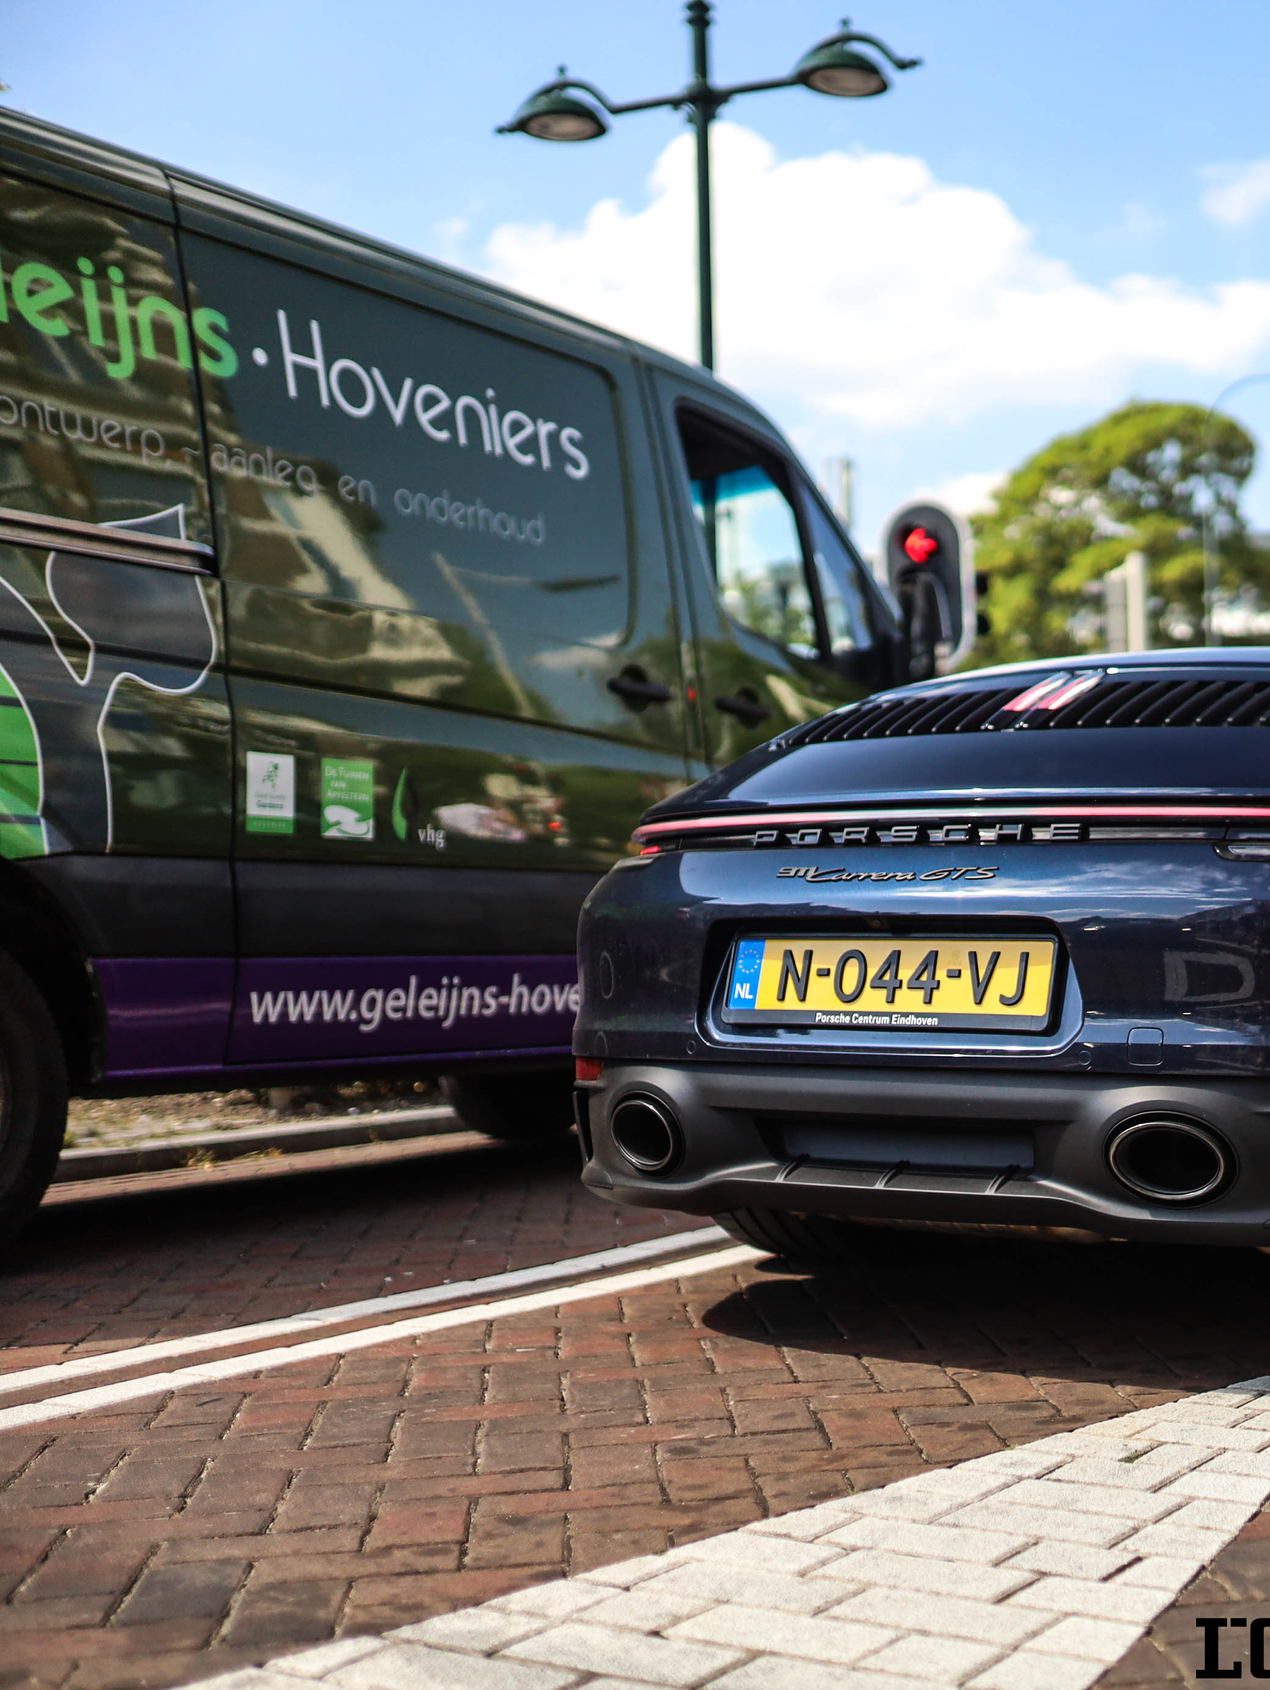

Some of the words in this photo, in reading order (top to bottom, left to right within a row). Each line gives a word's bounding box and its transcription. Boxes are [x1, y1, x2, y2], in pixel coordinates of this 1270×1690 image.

[277, 309, 590, 480] Hoveniers
[210, 442, 319, 500] aanleg
[338, 475, 377, 507] en
[394, 488, 546, 546] onderhoud
[418, 824, 445, 849] vhg
[753, 823, 1081, 847] PORSCHE
[806, 867, 917, 883] Carrera
[919, 866, 999, 881] GTS
[776, 949, 1030, 1006] N-044-VJ
[250, 972, 580, 1033] www.geleijns-hove
[734, 983, 754, 999] NL
[815, 1012, 850, 1024] Porsche
[851, 1013, 890, 1025] Centrum
[891, 1014, 938, 1026] Eindhoven
